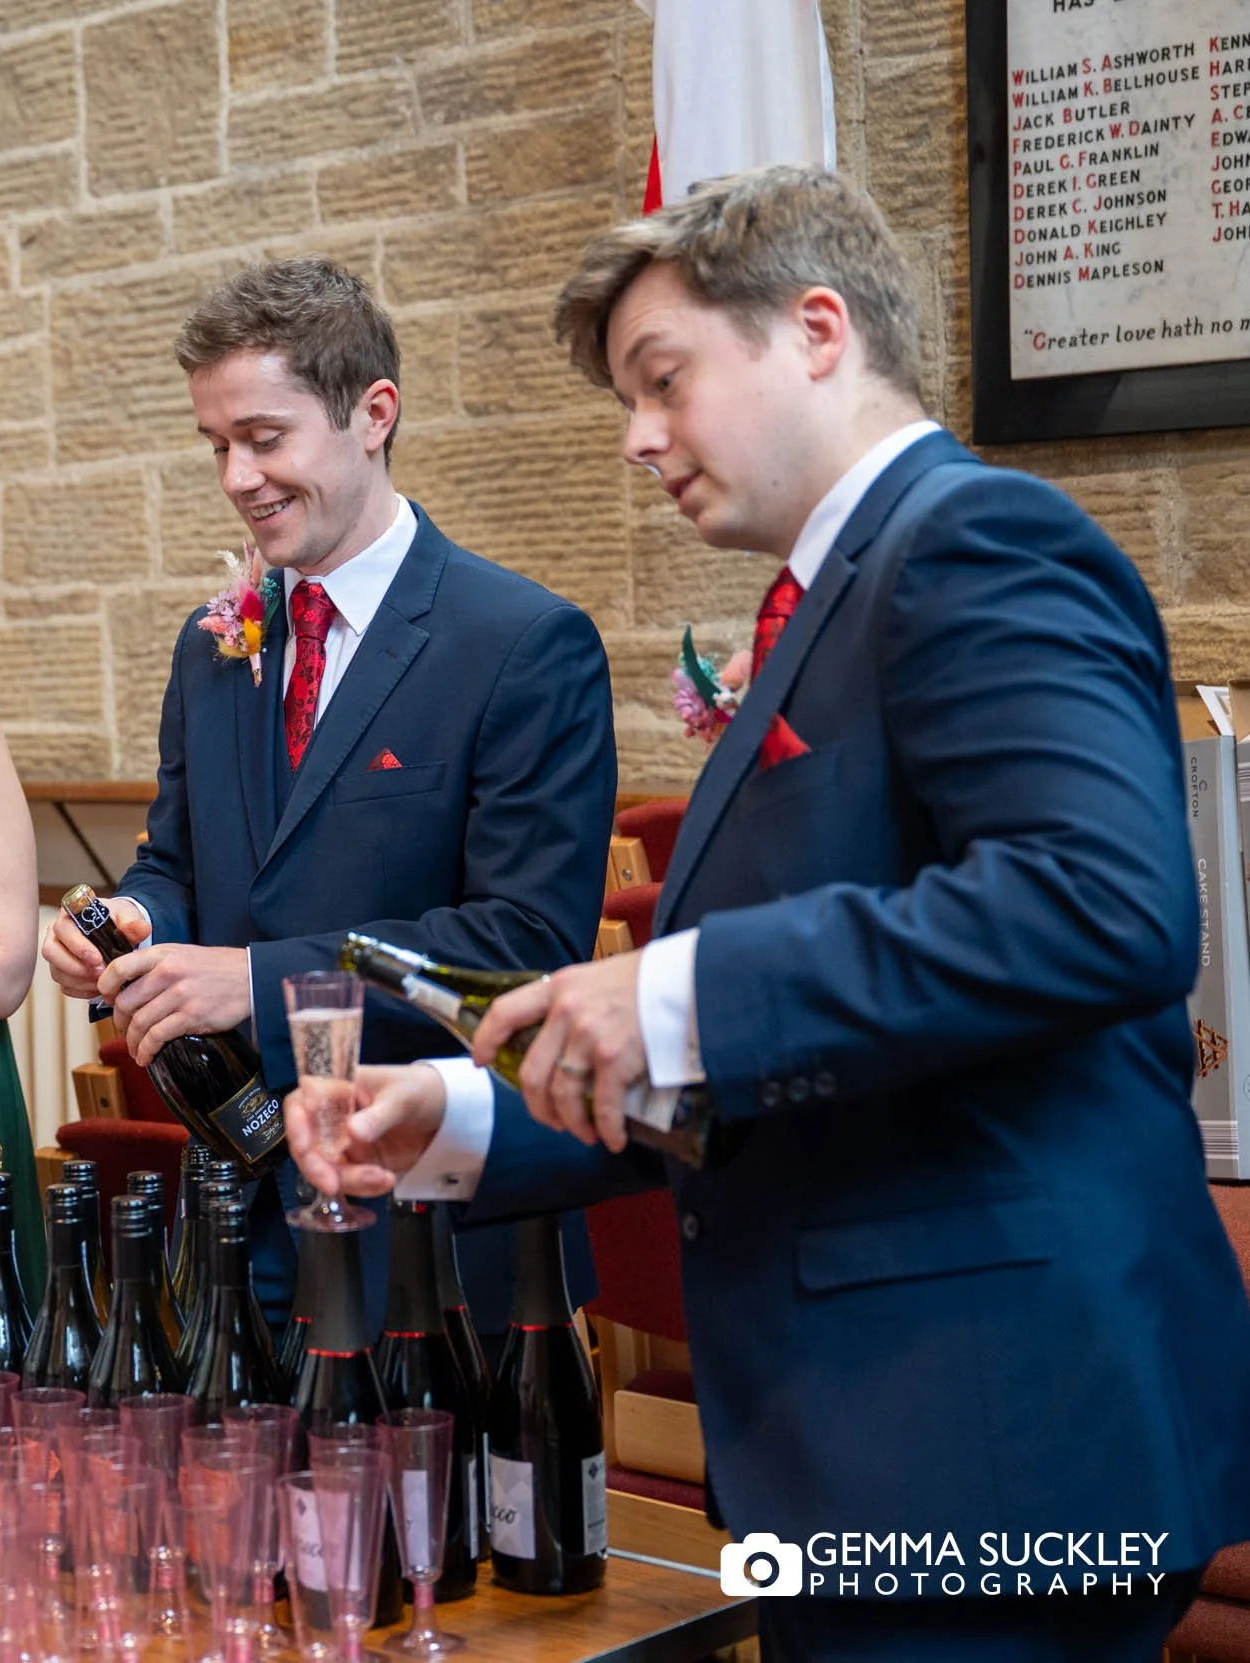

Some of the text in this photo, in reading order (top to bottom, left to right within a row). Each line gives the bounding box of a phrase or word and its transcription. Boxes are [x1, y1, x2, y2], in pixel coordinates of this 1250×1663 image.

[1012, 42, 1195, 87] WILLIAM S. ASHWORTH
[1209, 57, 1250, 77] HAR
[1012, 66, 1200, 109] WILLIAM K. BELLHOUSE
[1013, 101, 1130, 132] JACK BUTLER
[1212, 107, 1228, 125] A.
[1013, 113, 1196, 154] FREDERICK W. DAINTY
[1211, 129, 1250, 149] EDW
[1013, 159, 1054, 177] PAUL
[1078, 142, 1160, 168] FRANKLIN
[1013, 180, 1067, 200] DEREK
[1086, 168, 1141, 189] GREEN
[1014, 189, 1167, 222] DEREK C. JOHNSON
[1014, 212, 1167, 245] DONALD KEIGHLEY
[1015, 241, 1121, 268] JOHN A. KING
[1014, 259, 1164, 290] DENNIS MAPLESON
[1116, 324, 1156, 343] love
[1161, 315, 1203, 339] hath
[1210, 319, 1233, 334] no
[1190, 755, 1199, 818] CROFTON
[1197, 858, 1211, 967] CAKE STAND
[241, 1099, 279, 1137] NOZECO
